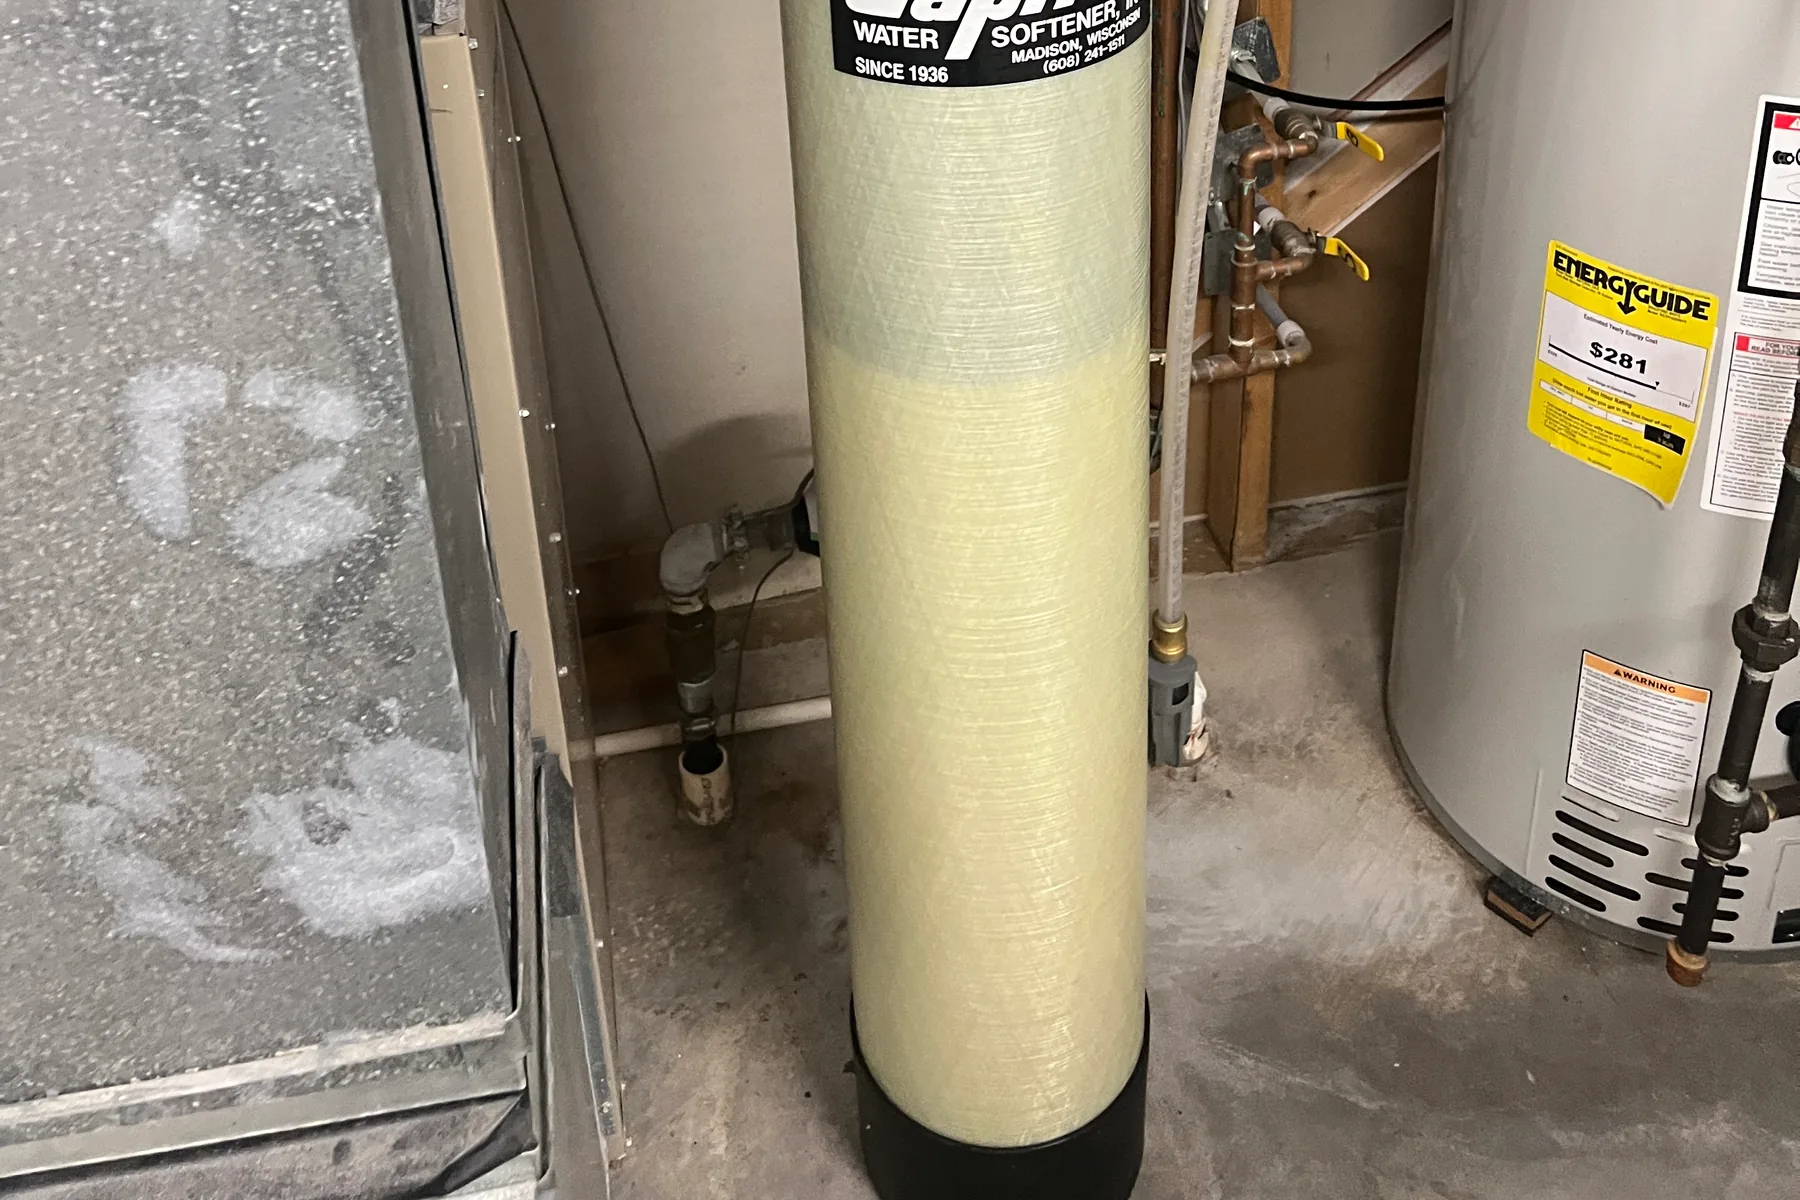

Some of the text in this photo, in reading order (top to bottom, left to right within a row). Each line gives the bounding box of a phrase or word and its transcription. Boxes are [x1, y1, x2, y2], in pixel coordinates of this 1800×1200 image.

[852, 20, 939, 50] WATER
[991, 0, 1121, 48] SOFTENER,
[1011, 6, 1141, 64] MADISON, WISCONSIN
[855, 56, 949, 84] SINCE 1936
[1043, 33, 1126, 75] (608) 241-1511
[1553, 249, 1711, 321] ENERGYGUIDE
[1583, 313, 1658, 345] Estimated Yearly Energy Cost
[1589, 341, 1647, 374] $281
[1772, 348, 1799, 357] BEFOR
[1620, 668, 1676, 694] WARNING
